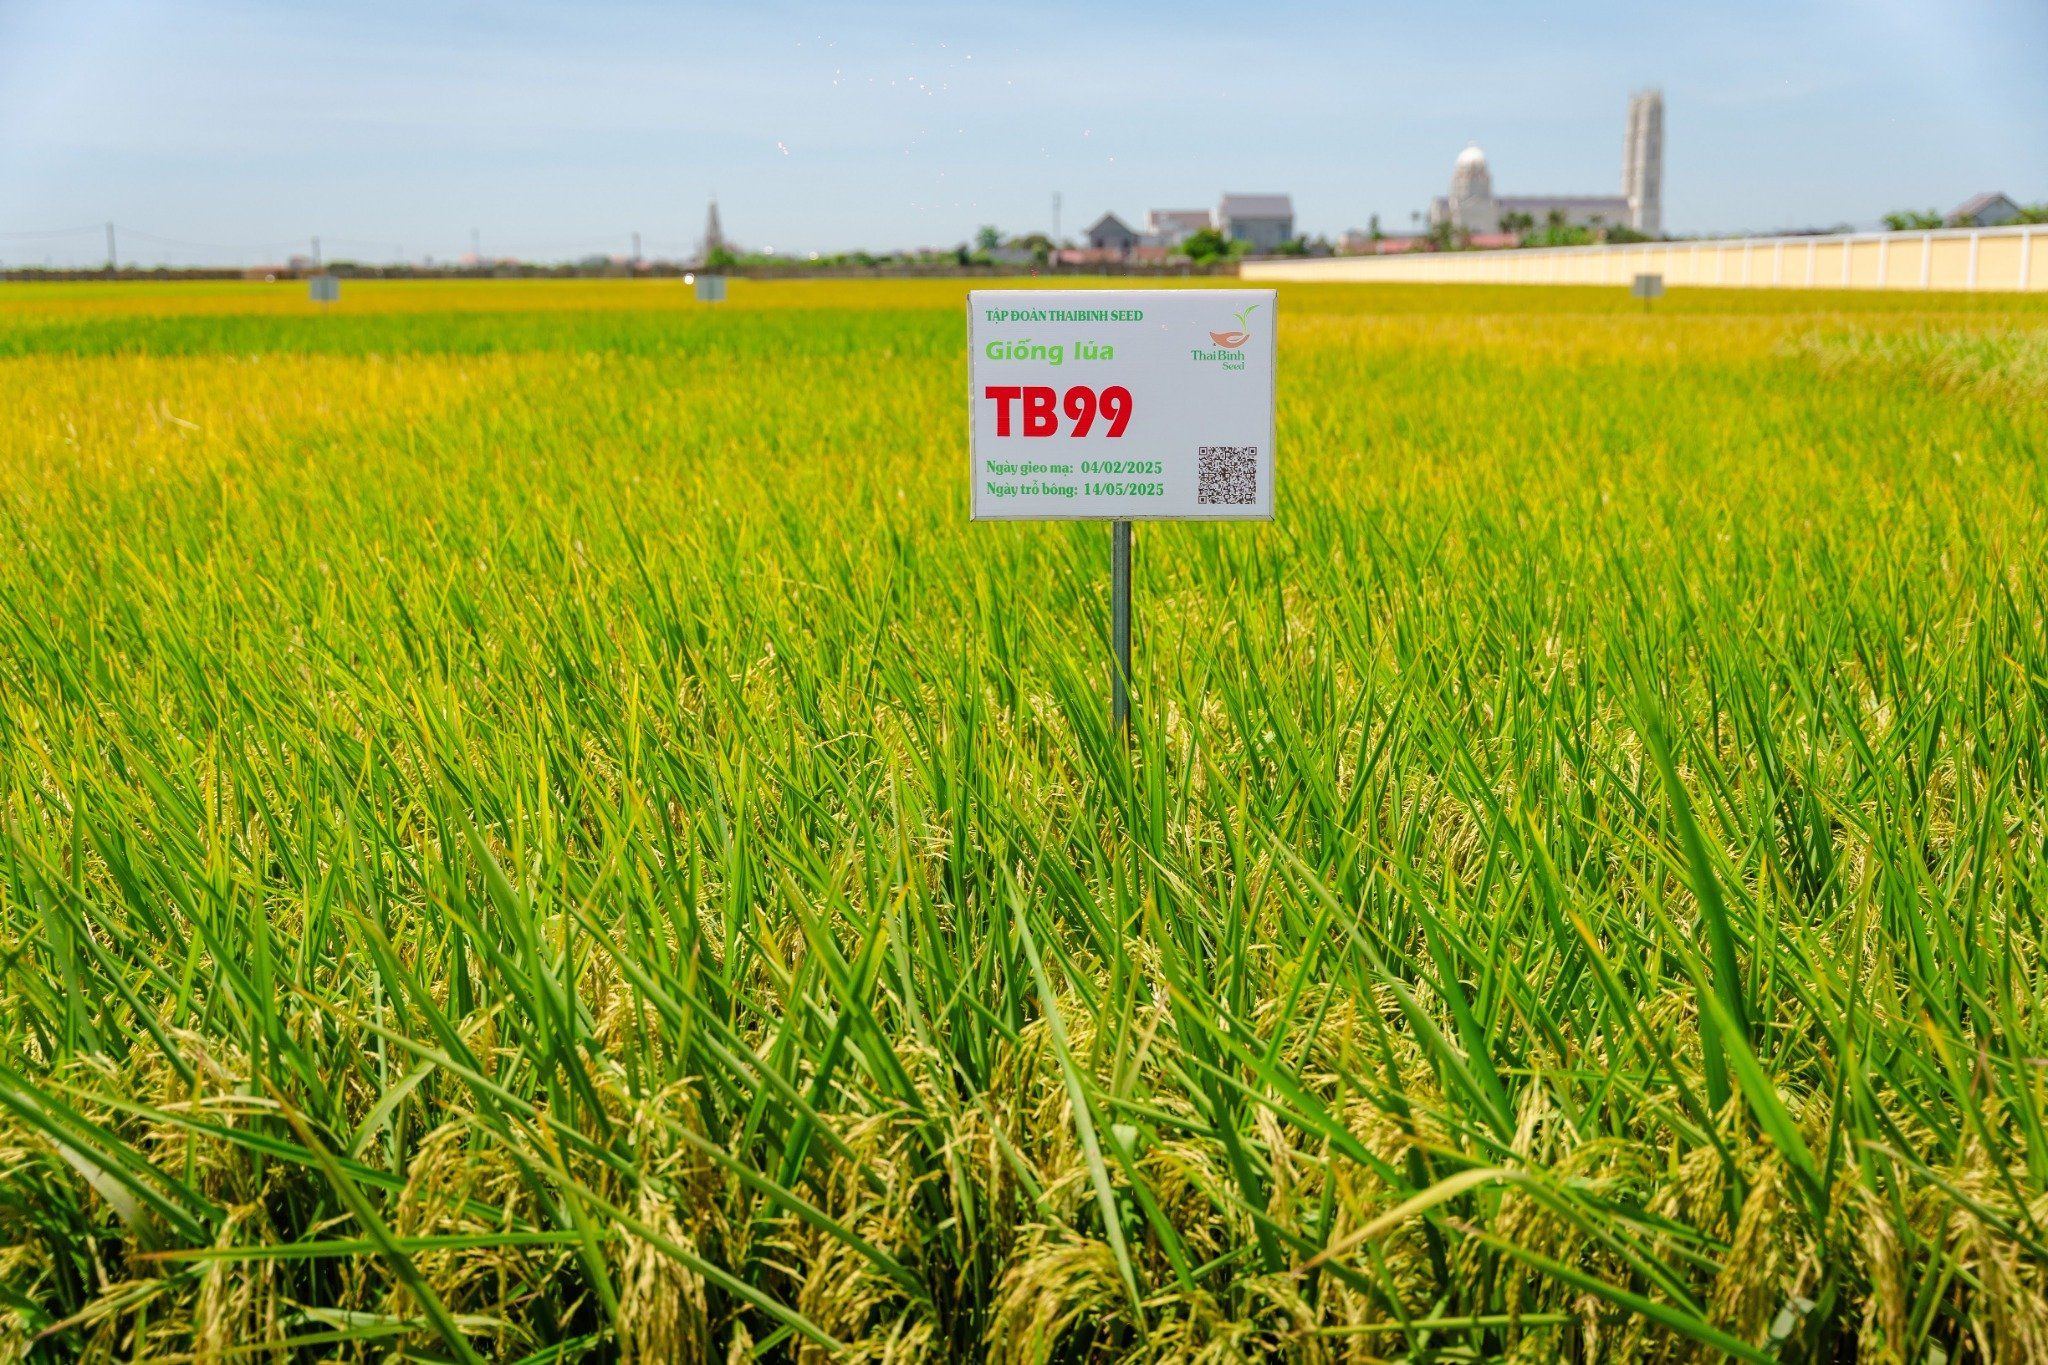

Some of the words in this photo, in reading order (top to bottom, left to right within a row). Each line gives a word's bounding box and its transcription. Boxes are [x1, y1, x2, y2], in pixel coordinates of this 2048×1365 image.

[986, 307, 1009, 324] TẬP
[1011, 307, 1046, 322] ĐOÀN
[1049, 310, 1109, 322] THAIBINH
[1111, 310, 1144, 322] SEED
[985, 339, 1064, 366] Giống
[1074, 340, 1114, 360] lúa
[1222, 361, 1245, 371] Seed
[985, 385, 1133, 438] TB99
[986, 460, 1018, 475] Ngày
[1020, 461, 1048, 475] gieo
[1050, 464, 1074, 477] mạ:
[1081, 461, 1162, 474] 04/02/2025
[986, 481, 1018, 497] Ngày
[1042, 482, 1078, 498] bông:
[1084, 482, 1164, 496] 14/05/2025
